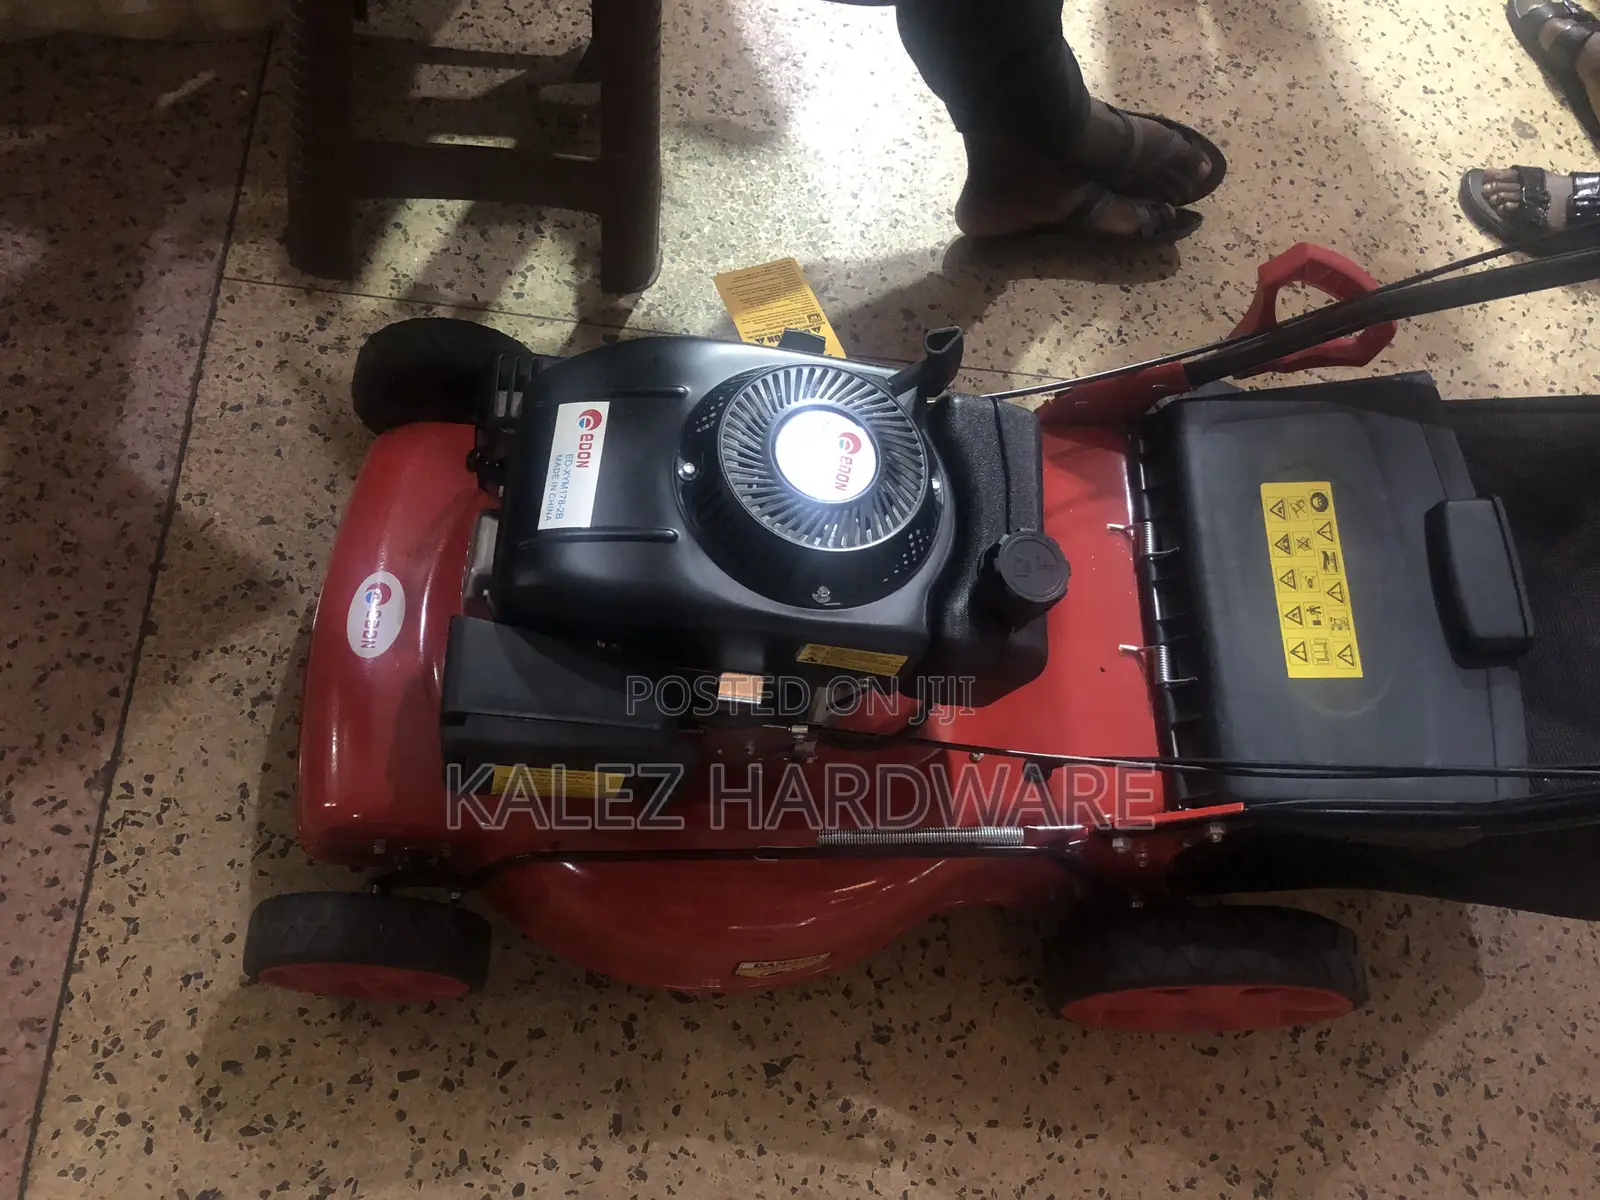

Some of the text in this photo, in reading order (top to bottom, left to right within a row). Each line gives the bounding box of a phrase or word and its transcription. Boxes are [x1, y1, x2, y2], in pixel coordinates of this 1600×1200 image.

[544, 454, 563, 522] MADE IN CHINA
[555, 453, 575, 520] ED-XYM178-2B
